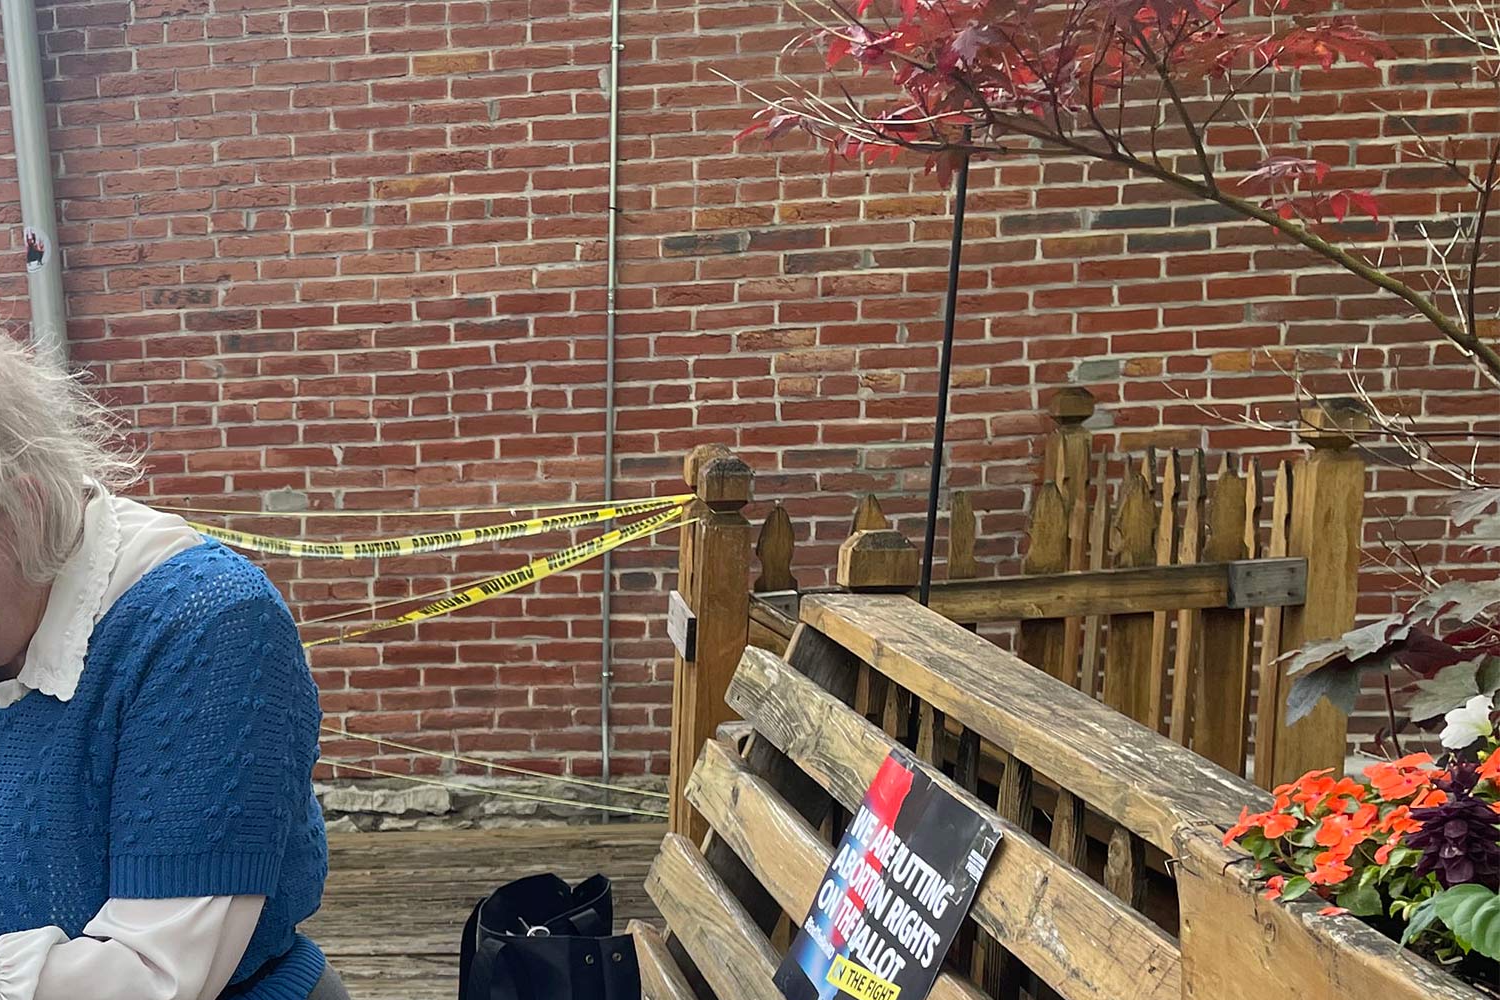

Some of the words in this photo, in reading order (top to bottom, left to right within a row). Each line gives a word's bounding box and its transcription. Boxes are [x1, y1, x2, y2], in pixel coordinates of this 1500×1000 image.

[851, 805, 880, 847] WE
[869, 824, 901, 869] ARE
[817, 879, 844, 919] ON
[834, 895, 862, 942] THE
[832, 843, 893, 920] ABORTION
[882, 895, 941, 968] RIGHTS
[847, 968, 867, 992] THE
